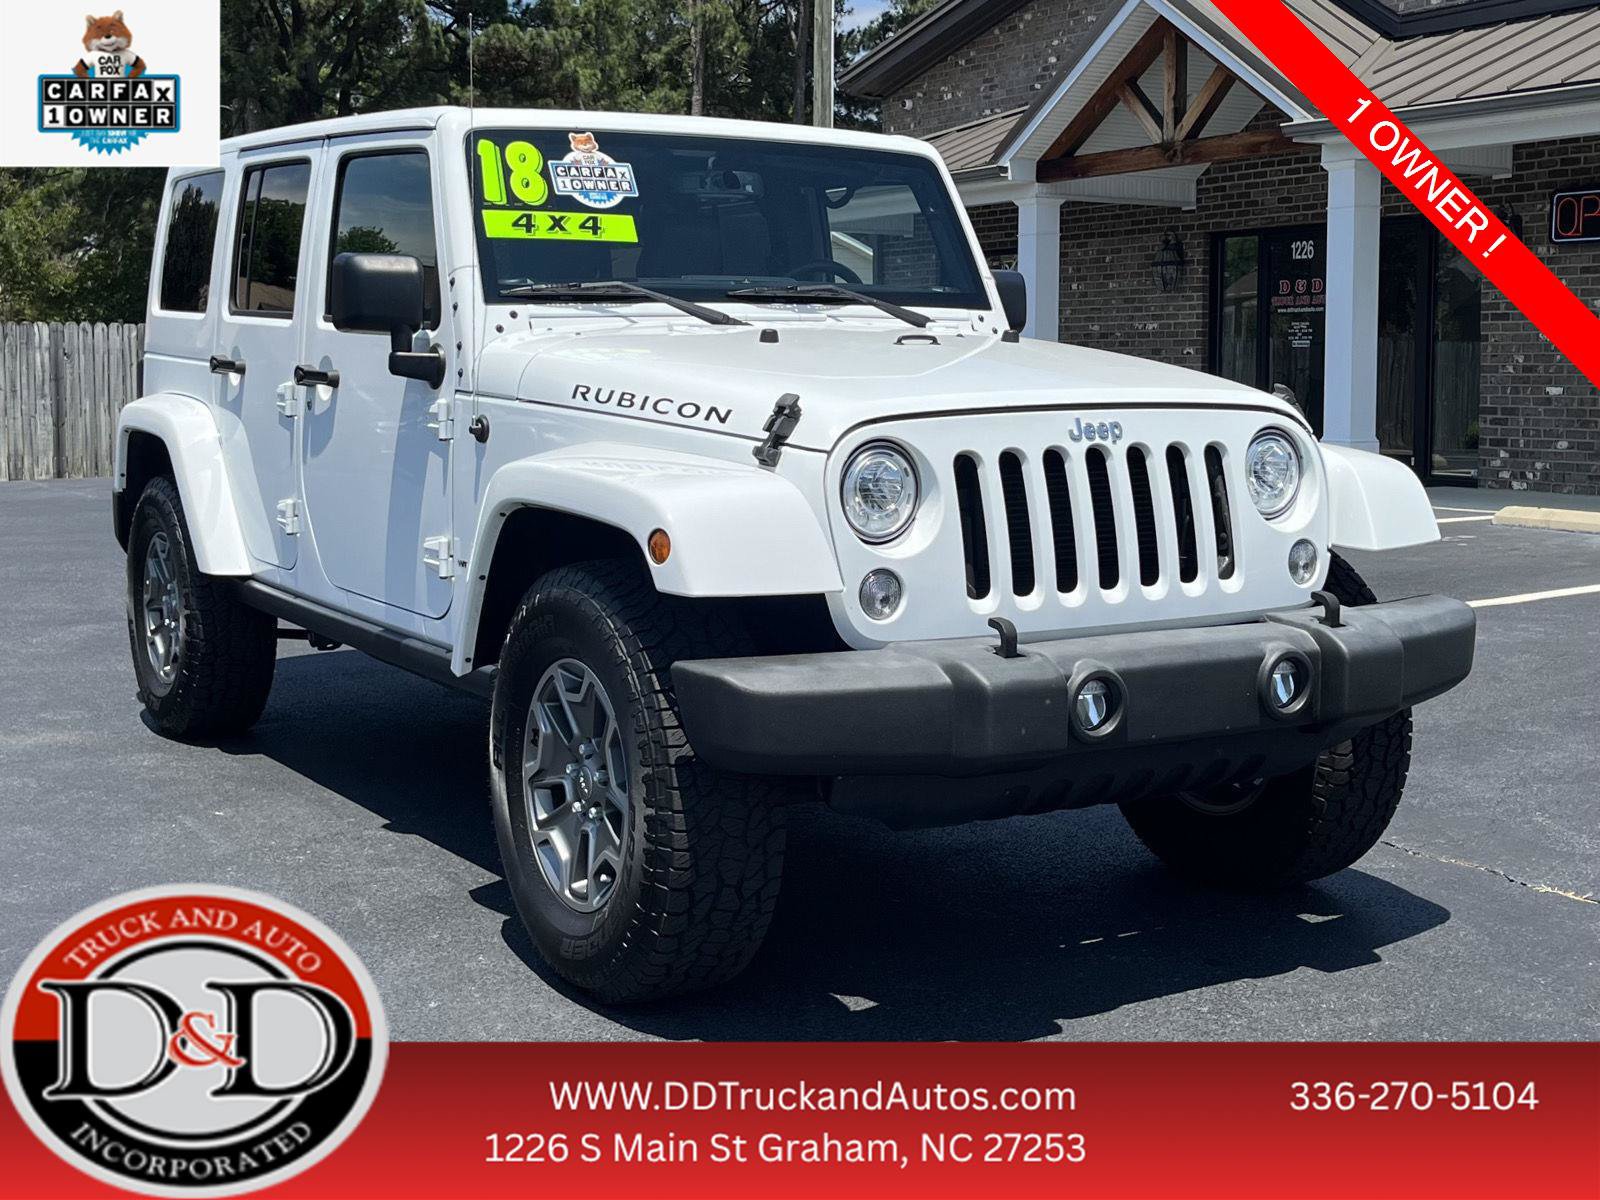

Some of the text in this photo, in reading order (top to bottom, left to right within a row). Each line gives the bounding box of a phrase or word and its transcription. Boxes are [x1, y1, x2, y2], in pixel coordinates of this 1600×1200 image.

[477, 139, 548, 205] 18
[556, 166, 627, 179] CARFAX
[1291, 240, 1314, 260] 1226
[1279, 279, 1291, 294] D
[1311, 278, 1324, 293] D
[571, 383, 734, 425] RUBICON
[1068, 417, 1123, 445] Jeep
